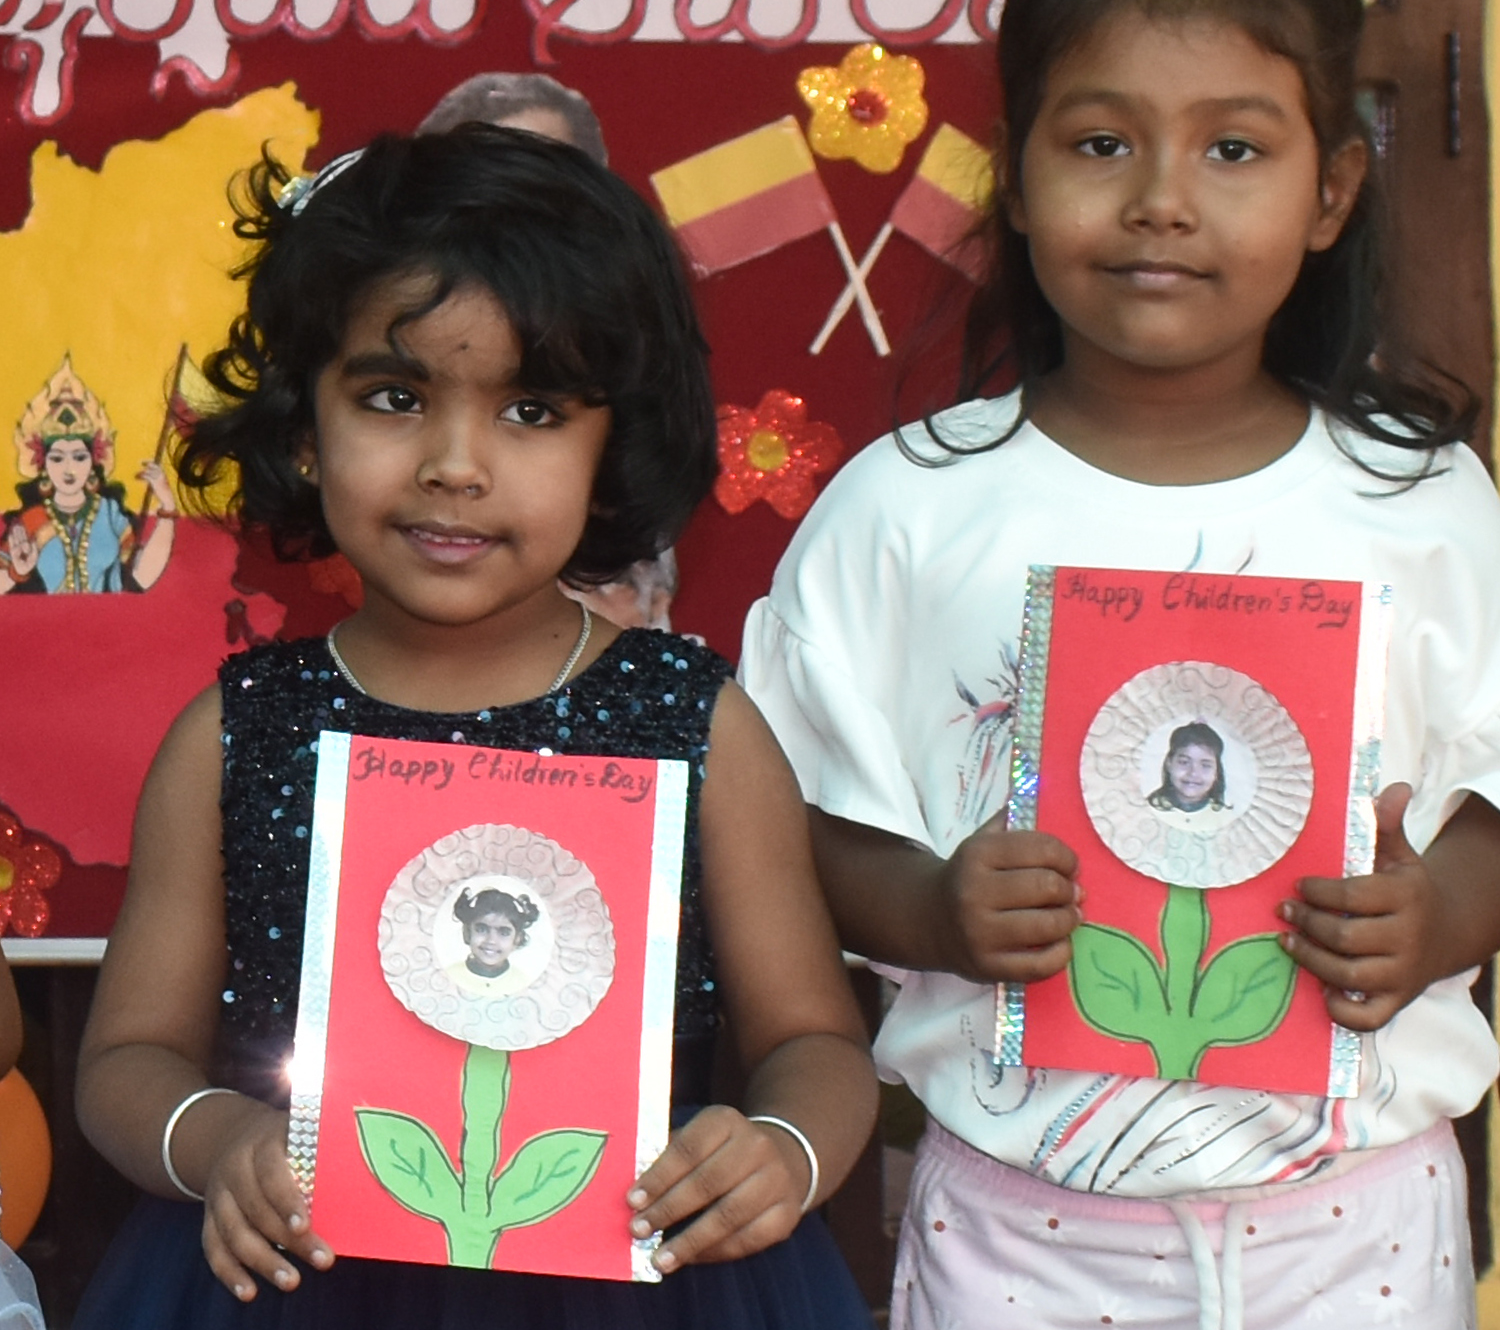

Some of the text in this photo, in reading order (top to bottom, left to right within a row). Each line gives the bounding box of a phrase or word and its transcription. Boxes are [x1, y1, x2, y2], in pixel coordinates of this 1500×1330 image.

[1062, 573, 1353, 628] Happy Children's Day
[352, 746, 653, 803] Happy Children's Day
